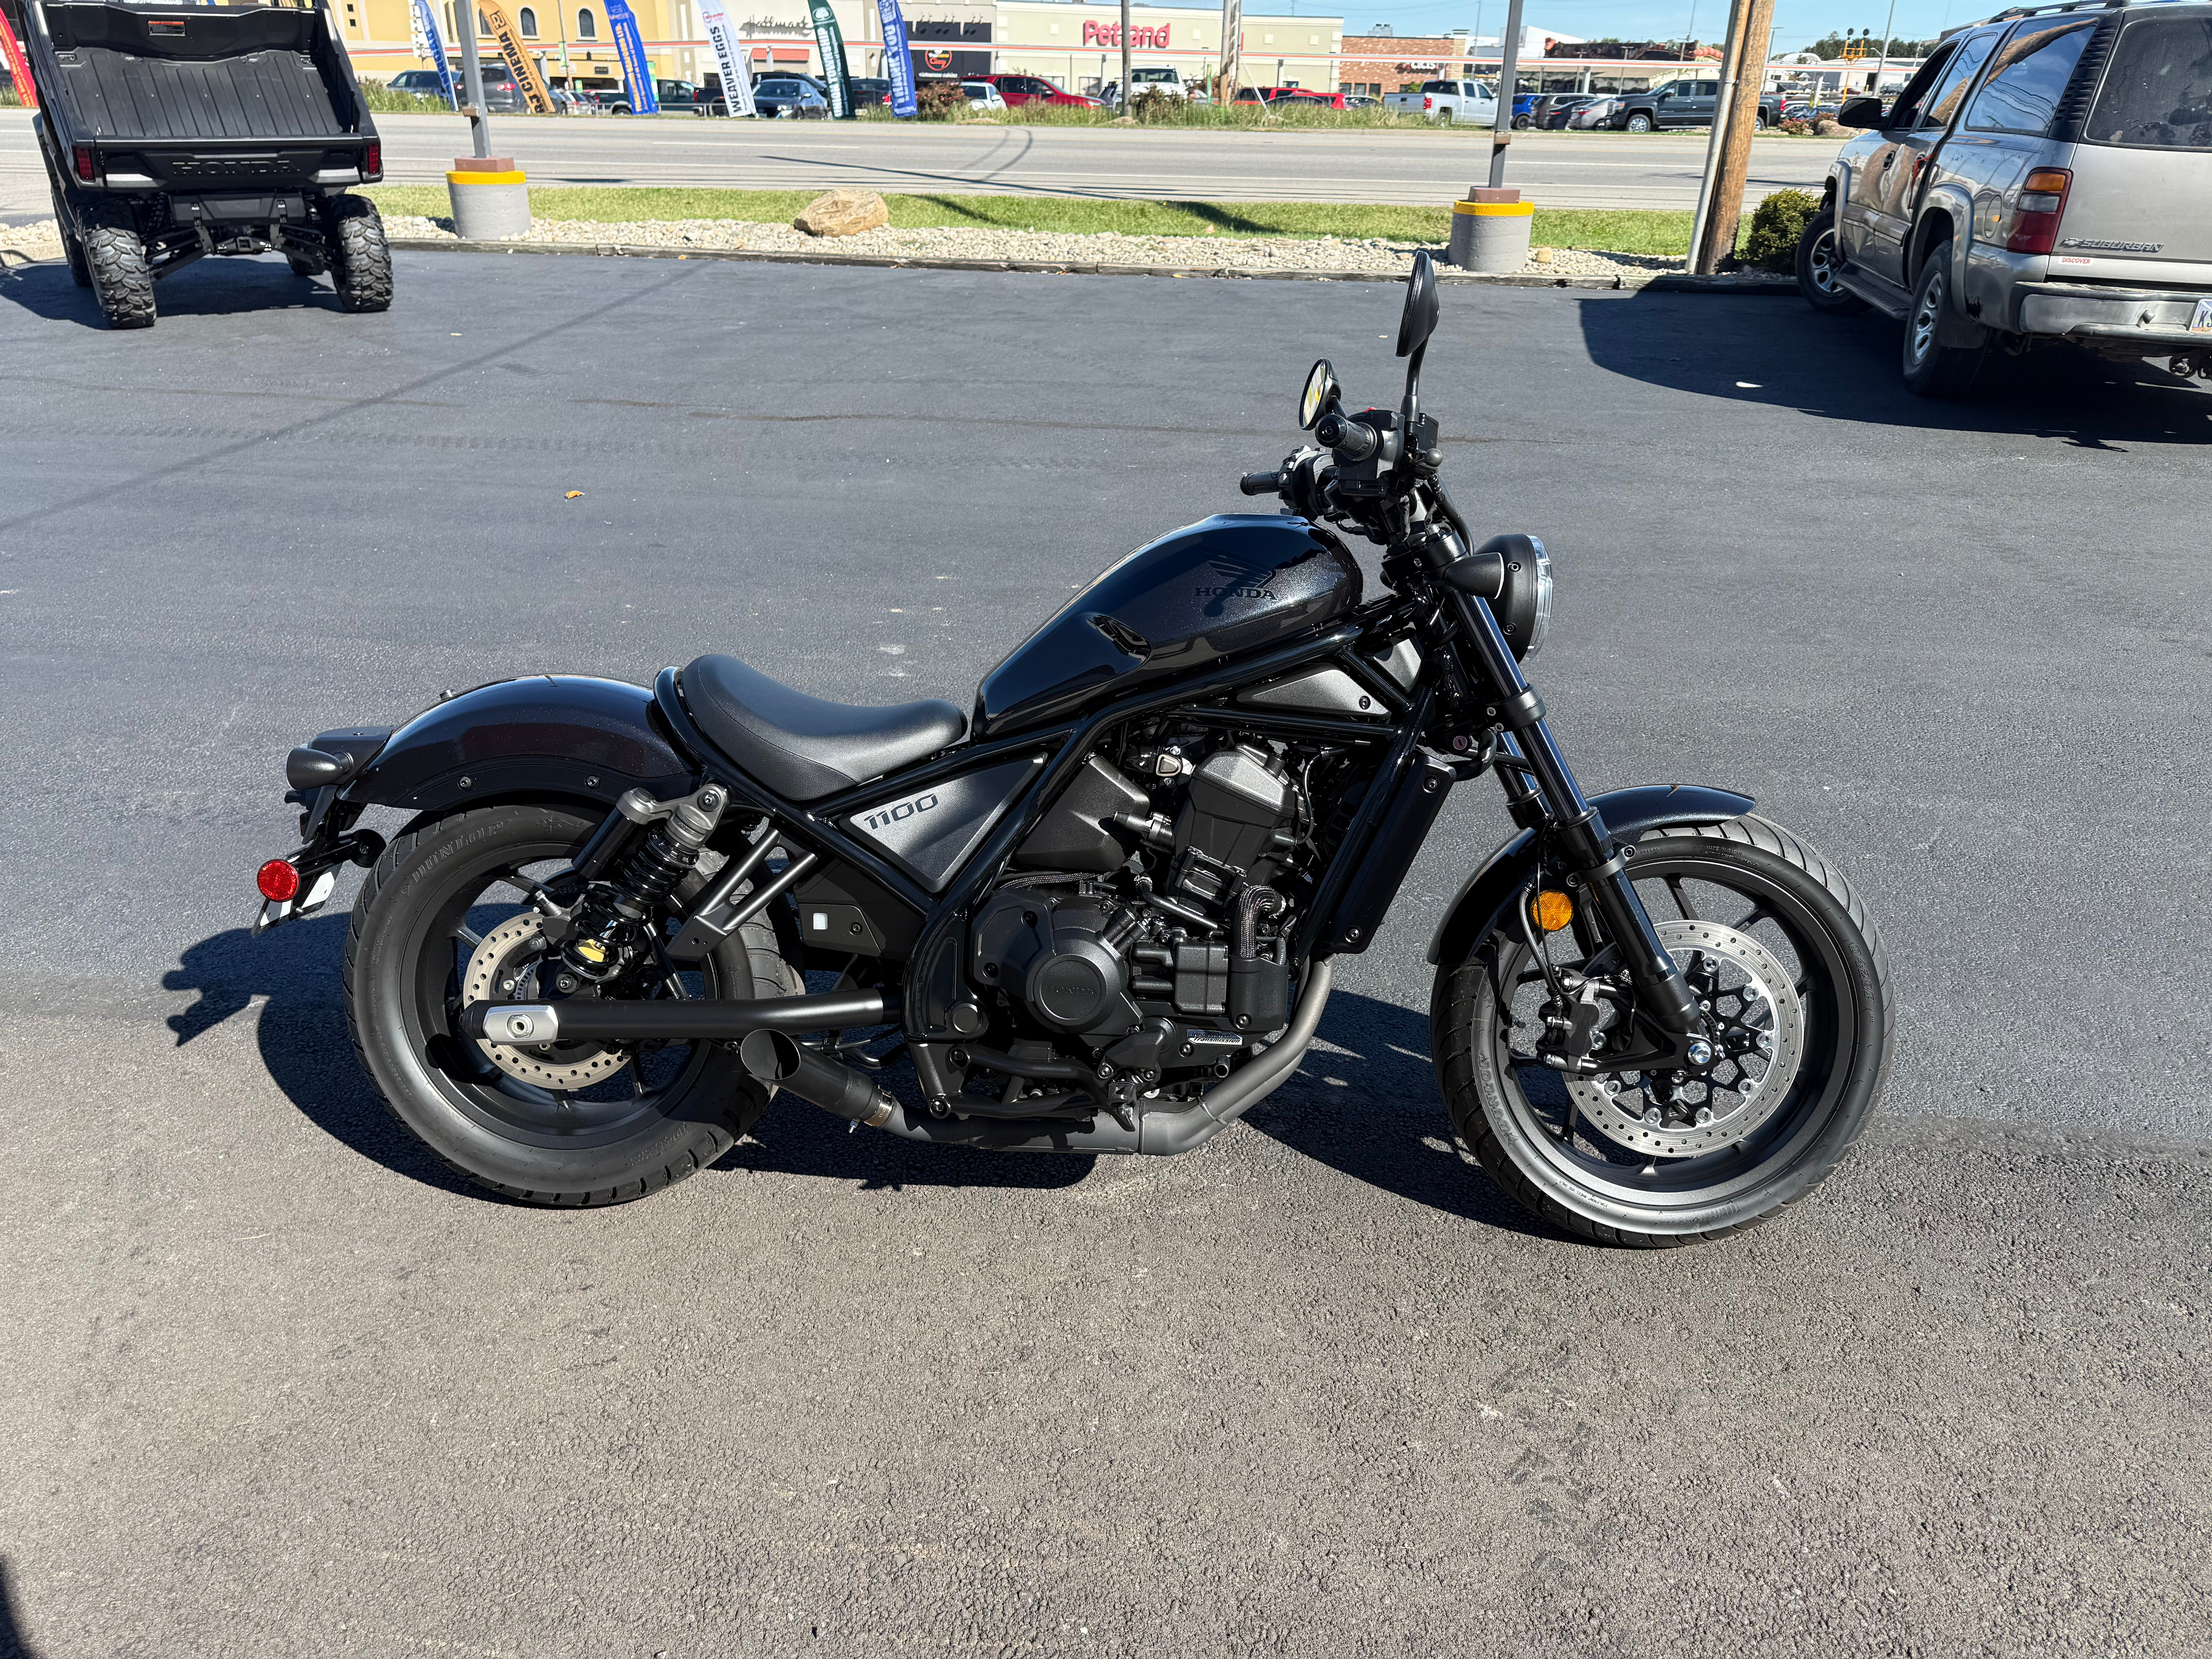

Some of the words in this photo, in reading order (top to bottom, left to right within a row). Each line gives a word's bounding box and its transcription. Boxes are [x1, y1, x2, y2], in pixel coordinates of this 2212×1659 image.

[710, 26, 727, 59] EGGS
[884, 24, 898, 57] YOU
[1085, 20, 1171, 46] Petand
[498, 31, 533, 92] CINEMA
[817, 27, 838, 84] TOWNSHIP
[721, 60, 742, 113] WEAVER
[888, 55, 905, 107] THANK
[829, 83, 843, 117] UNION
[173, 160, 300, 174] HONDA
[2080, 239, 2165, 252] SUBURBAN
[1194, 587, 1279, 600] HONDA
[864, 793, 939, 830] 1100
[411, 821, 503, 884] DUNLOP
[1848, 942, 1875, 1002] D428F
[1046, 986, 1097, 996] HONDA
[1479, 1055, 1511, 1132] DUNLOP
[1582, 1202, 1605, 1215] TUBELESS
